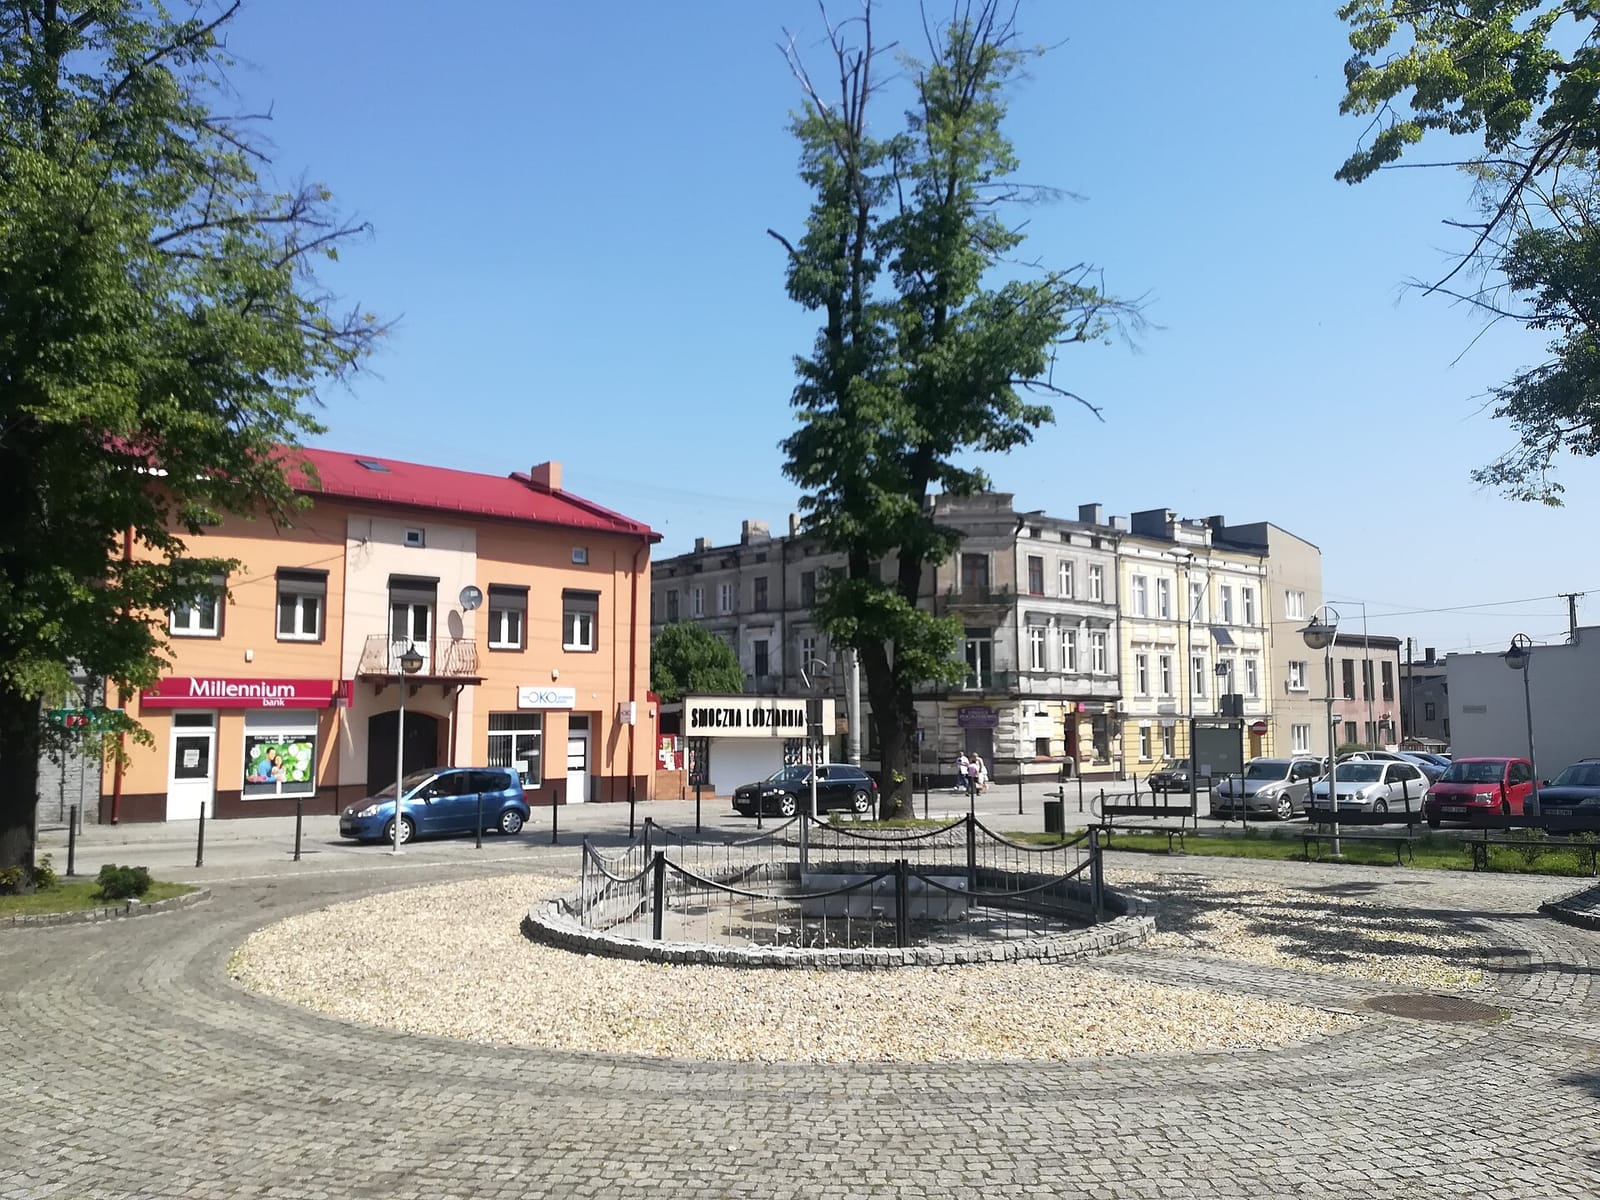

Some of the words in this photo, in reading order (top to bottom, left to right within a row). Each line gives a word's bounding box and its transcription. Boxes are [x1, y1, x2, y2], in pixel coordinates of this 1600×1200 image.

[189, 677, 295, 697] Millennium
[262, 698, 285, 707] bank
[529, 691, 557, 703] OKO
[691, 708, 741, 727] SMOCZNA
